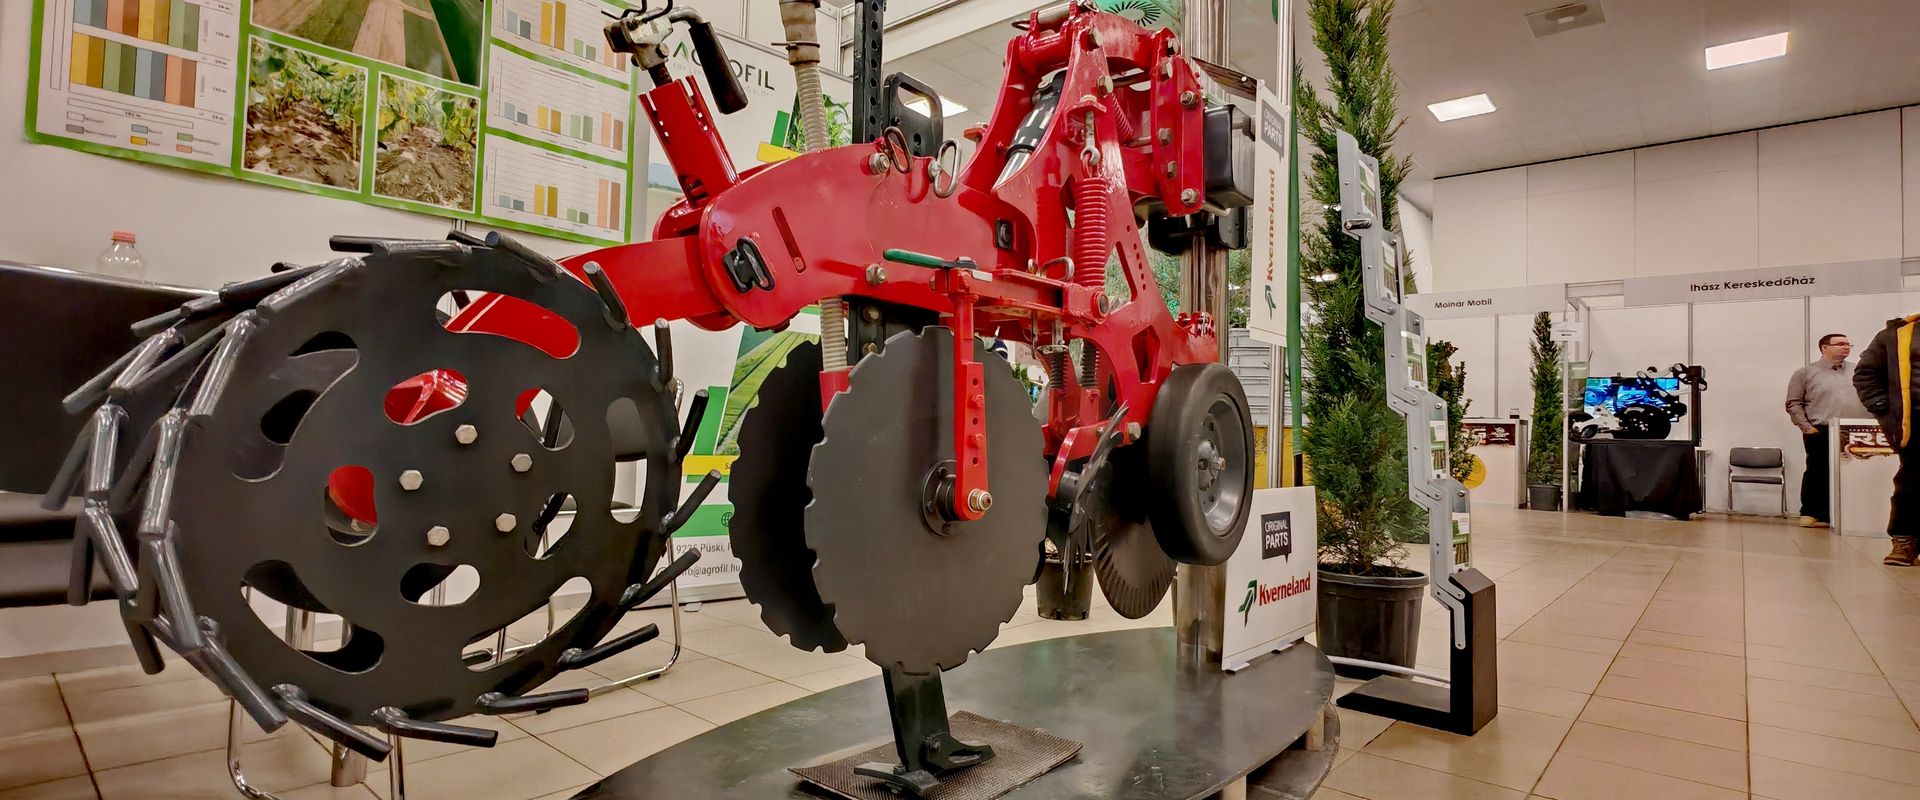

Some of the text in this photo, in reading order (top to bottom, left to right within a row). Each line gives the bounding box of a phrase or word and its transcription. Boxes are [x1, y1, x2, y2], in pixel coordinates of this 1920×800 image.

[1264, 121, 1283, 148] PARTS
[1266, 168, 1275, 282] Kverneland
[1690, 276, 1815, 292] Ihász Kereskedőház
[1467, 297, 1492, 307] Mobil
[1264, 519, 1289, 533] ORIGINAL
[700, 542, 725, 553] Püski,
[1265, 532, 1289, 550] PARTS
[1259, 571, 1311, 606] Kverneland
